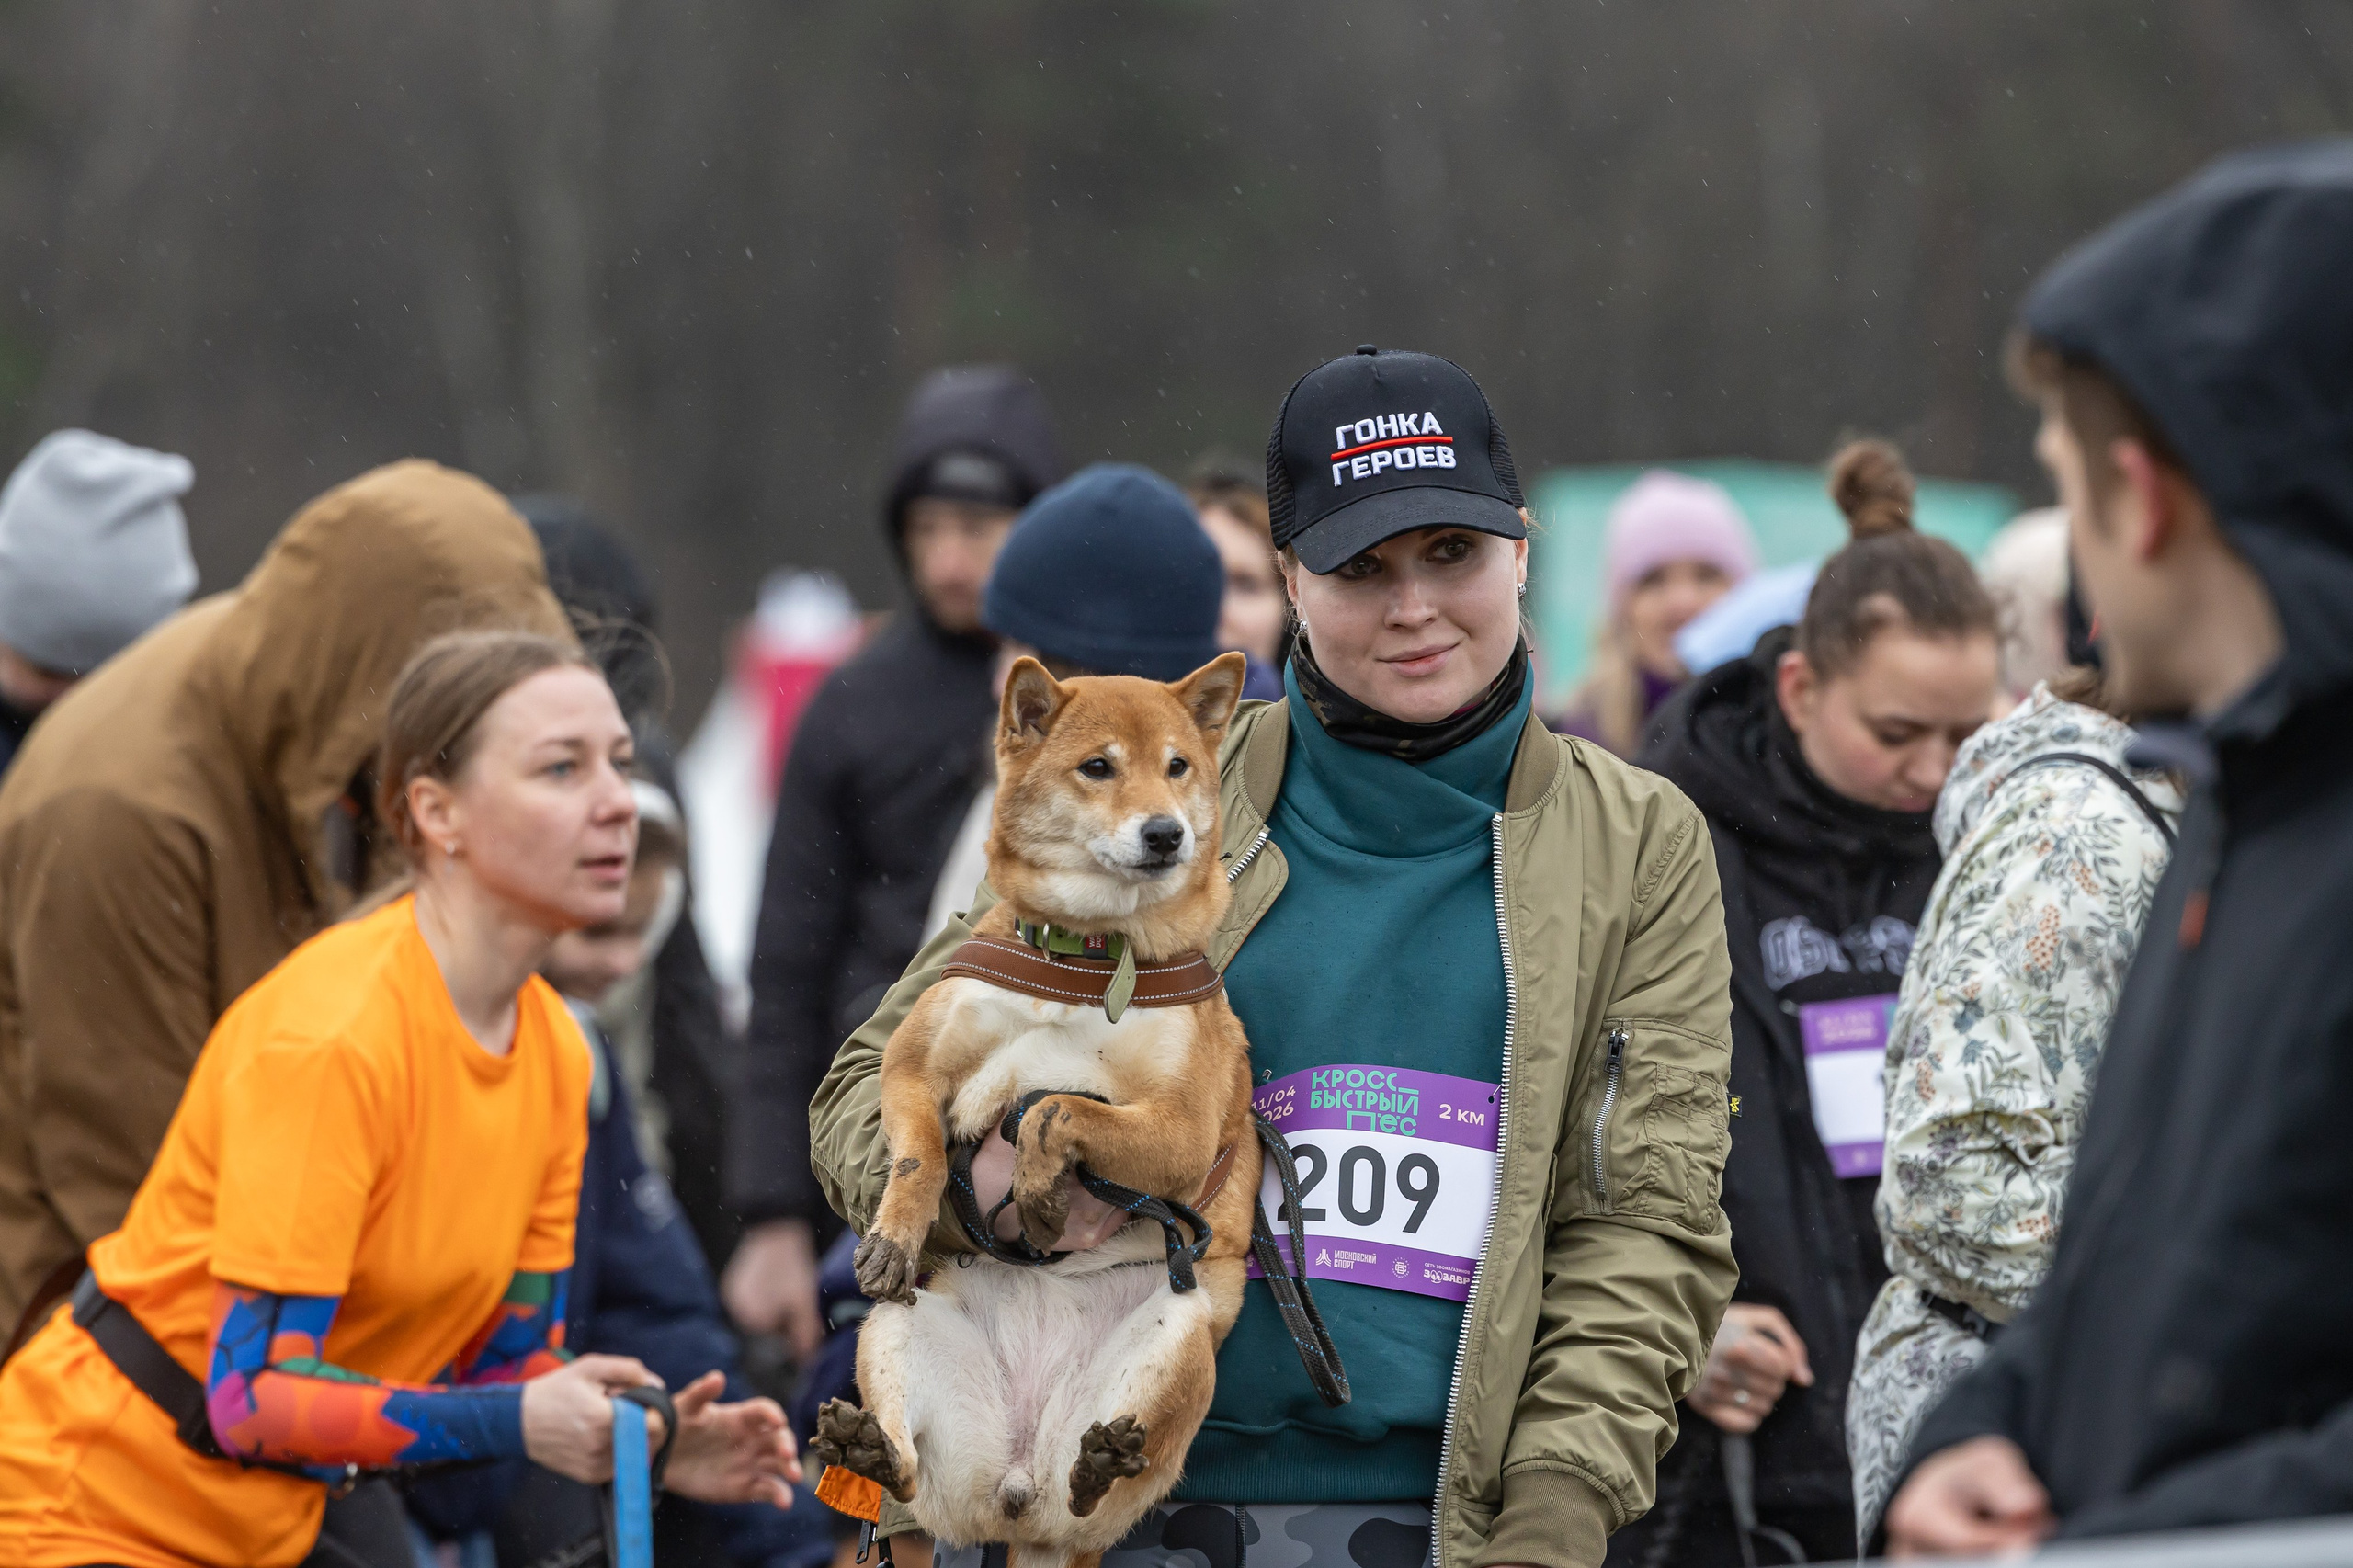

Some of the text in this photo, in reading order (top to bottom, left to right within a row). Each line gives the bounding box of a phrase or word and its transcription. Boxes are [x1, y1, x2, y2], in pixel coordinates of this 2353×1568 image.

[1336, 412, 1444, 450] ГОНКА
[1332, 446, 1457, 487] ГЕРОЕВ
[1312, 1069, 1398, 1091] КРОСС
[1251, 1085, 1296, 1111] 11/04
[1310, 1087, 1420, 1116] БЫСТРЫЙ
[1262, 1101, 1294, 1122] 026
[1439, 1103, 1452, 1119] 2
[1277, 1144, 1440, 1234] 209
[1334, 1250, 1377, 1265] МОСКОВСКИЙ
[1334, 1260, 1356, 1269] СПОРТ
[1436, 1265, 1471, 1275] ЗООМАГАЗИНОВ
